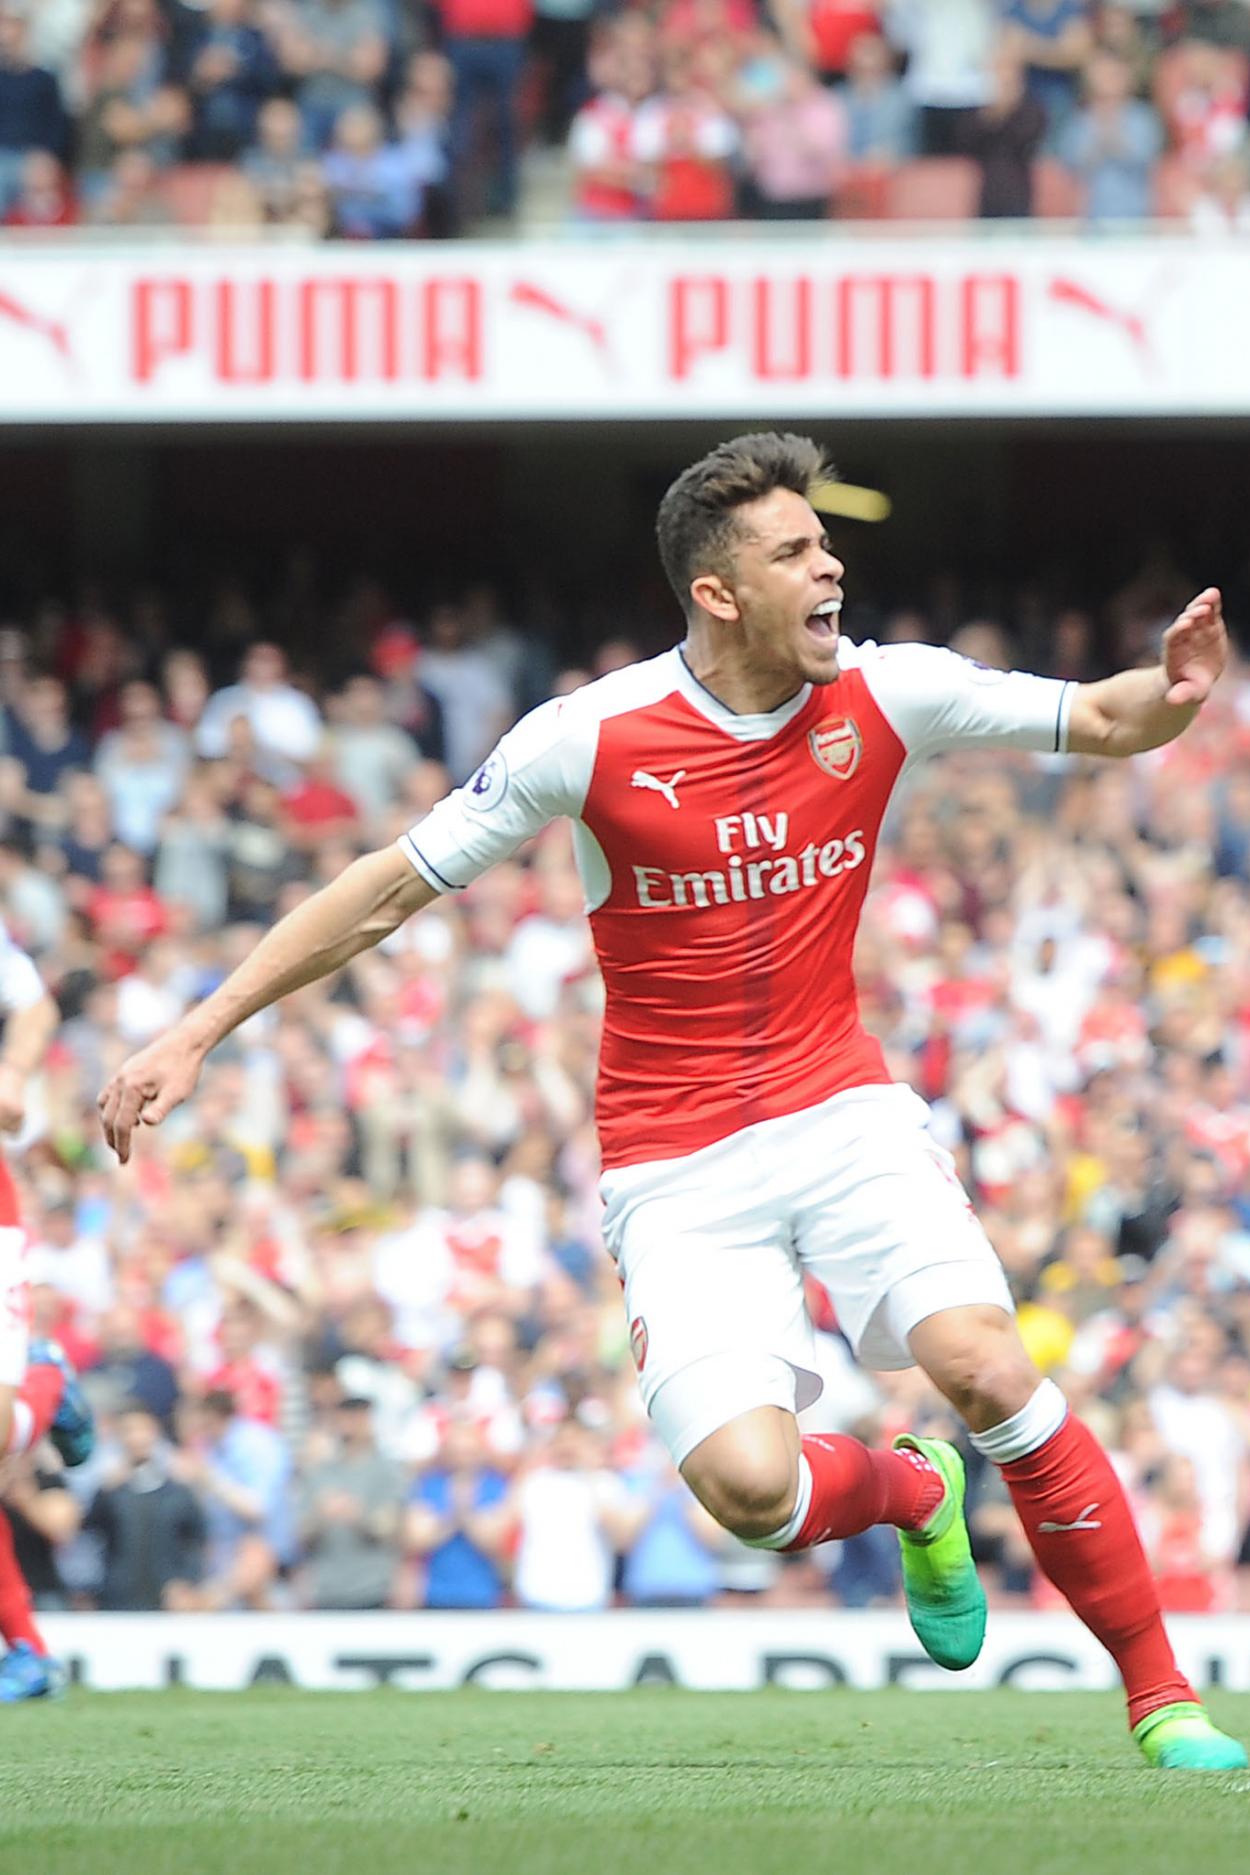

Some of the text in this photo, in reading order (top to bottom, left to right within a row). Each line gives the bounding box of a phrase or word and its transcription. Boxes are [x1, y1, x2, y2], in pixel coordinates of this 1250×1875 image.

[131, 272, 1022, 386] PUMA PUMA
[631, 829, 867, 908] Emirates
[714, 811, 789, 853] Fly
